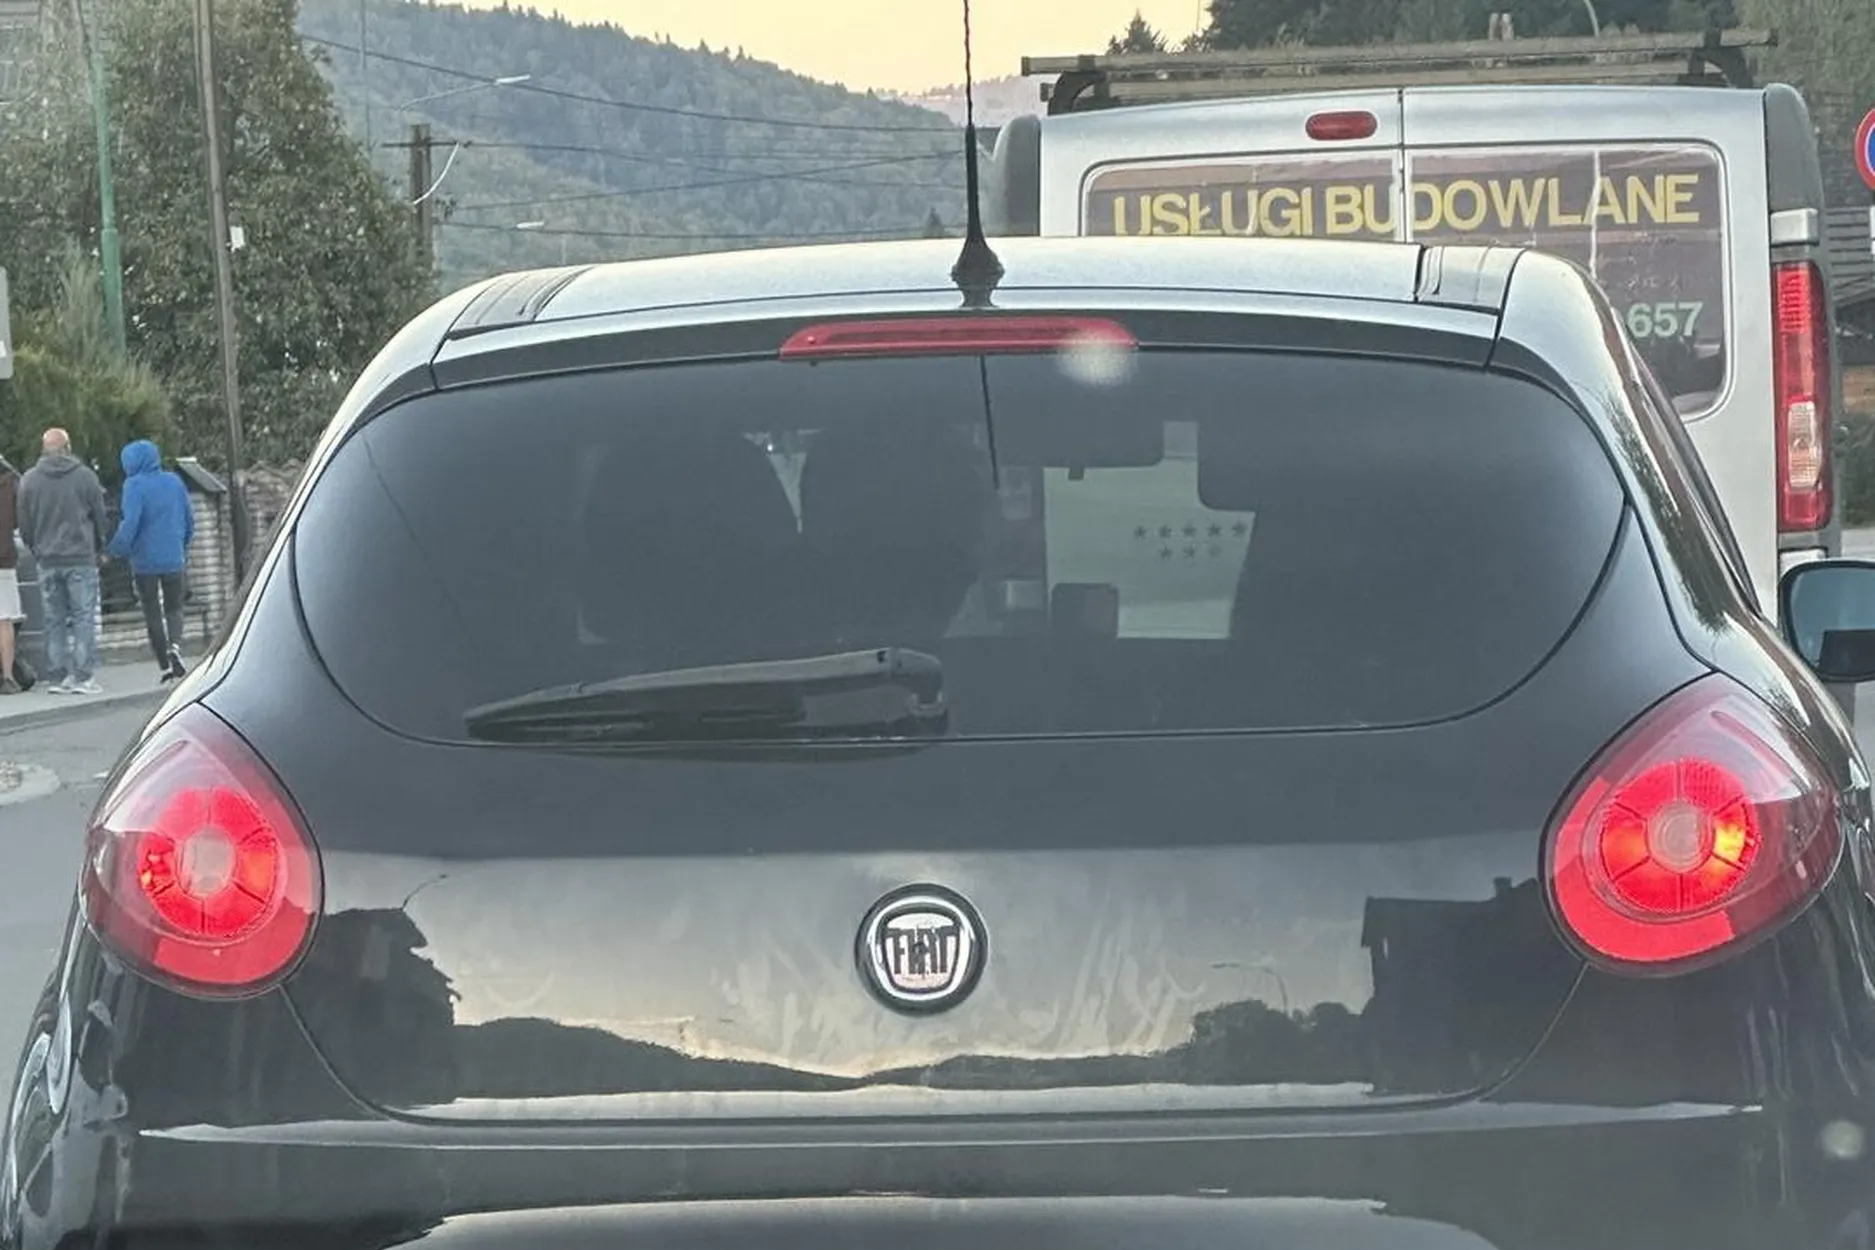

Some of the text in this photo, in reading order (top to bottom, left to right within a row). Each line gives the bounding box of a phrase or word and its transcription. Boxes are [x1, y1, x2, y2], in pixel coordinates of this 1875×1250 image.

[1114, 174, 1699, 236] USŁUGI BUDOWLANE
[1627, 302, 1703, 338] 657
[885, 926, 959, 975] FIAT
